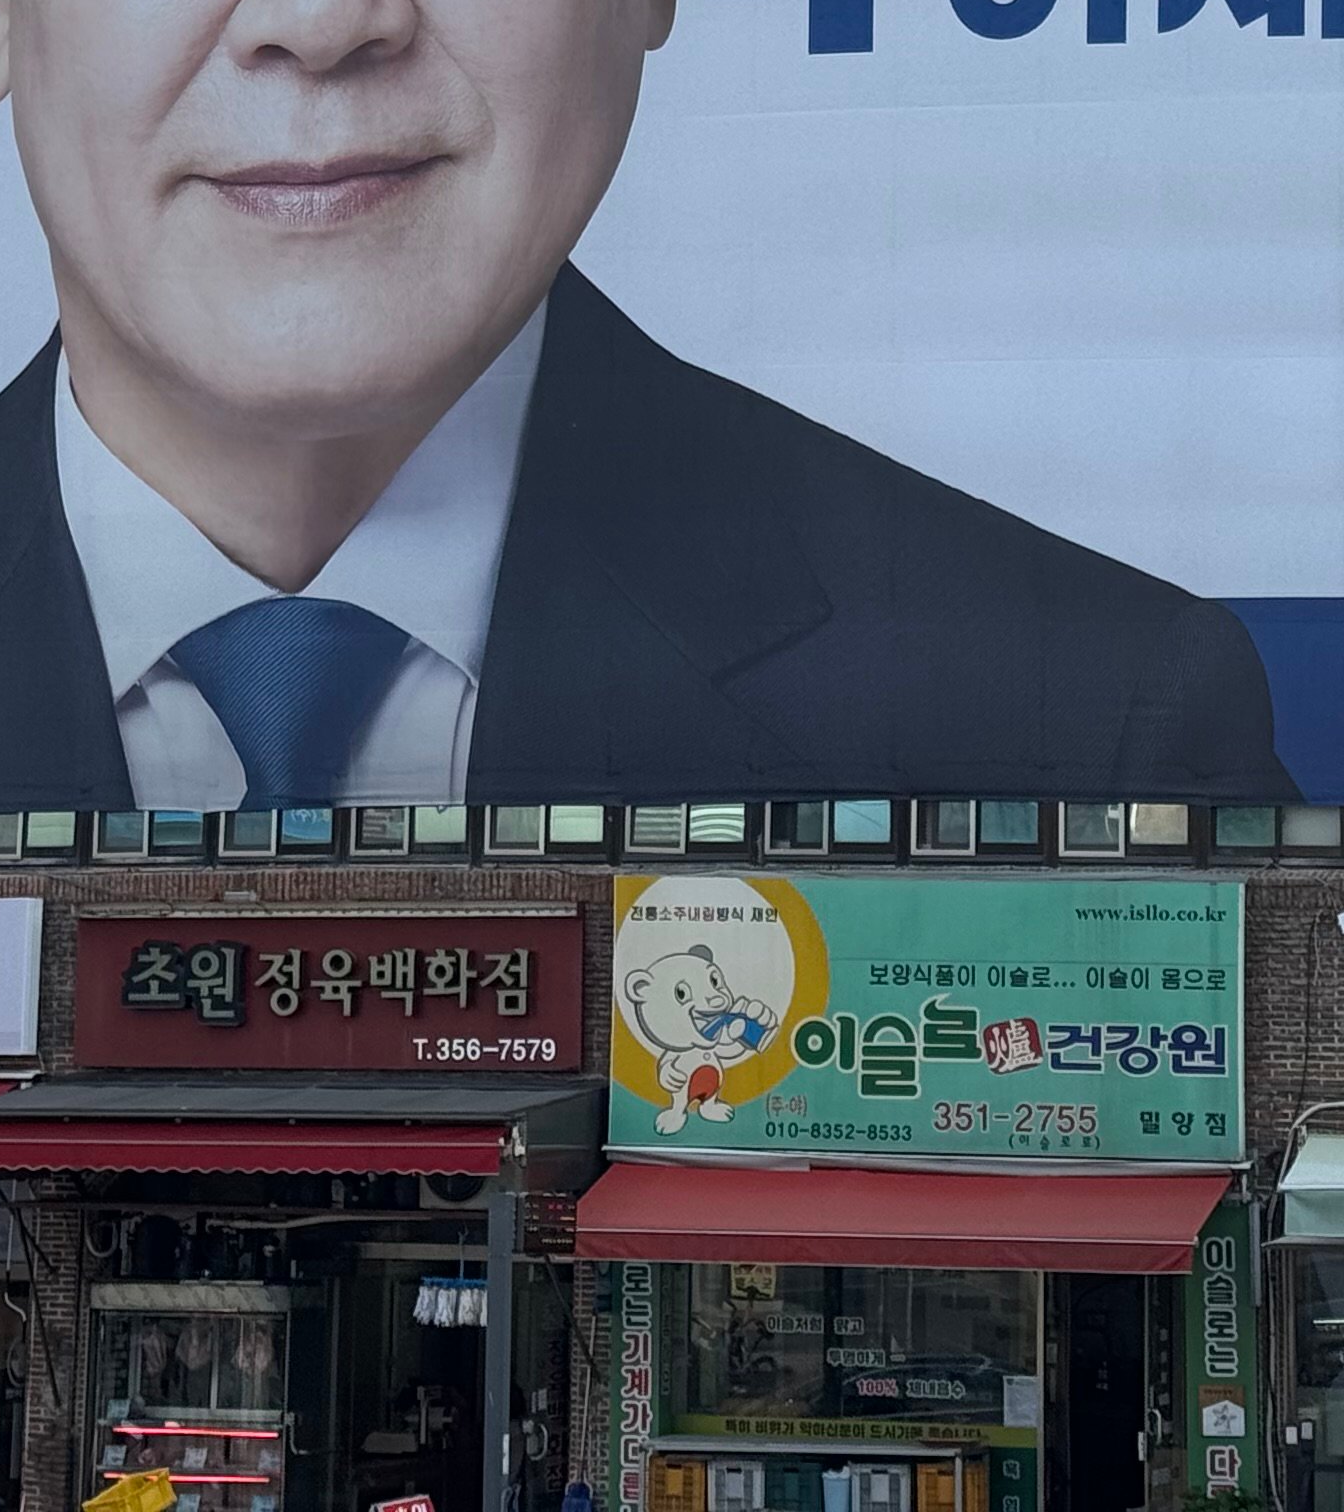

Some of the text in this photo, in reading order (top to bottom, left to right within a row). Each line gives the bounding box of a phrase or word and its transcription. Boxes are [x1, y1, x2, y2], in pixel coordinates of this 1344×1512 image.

[1075, 904, 1228, 925] www.isllo.co.kr
[123, 941, 537, 1024] 초원 정육백화점
[869, 963, 977, 988] 보양식품이
[1086, 965, 1151, 990] 이슬이
[1161, 966, 1228, 991] 몸으로
[412, 1037, 556, 1062] T.356-7579
[792, 993, 983, 1100] 이슬로
[1046, 1021, 1229, 1078] 건강원
[765, 1121, 913, 1142] 010-8352-8533
[933, 1101, 1098, 1136] 351-2755
[1202, 1237, 1238, 1378] 이슬로는
[856, 1378, 899, 1397] 100%
